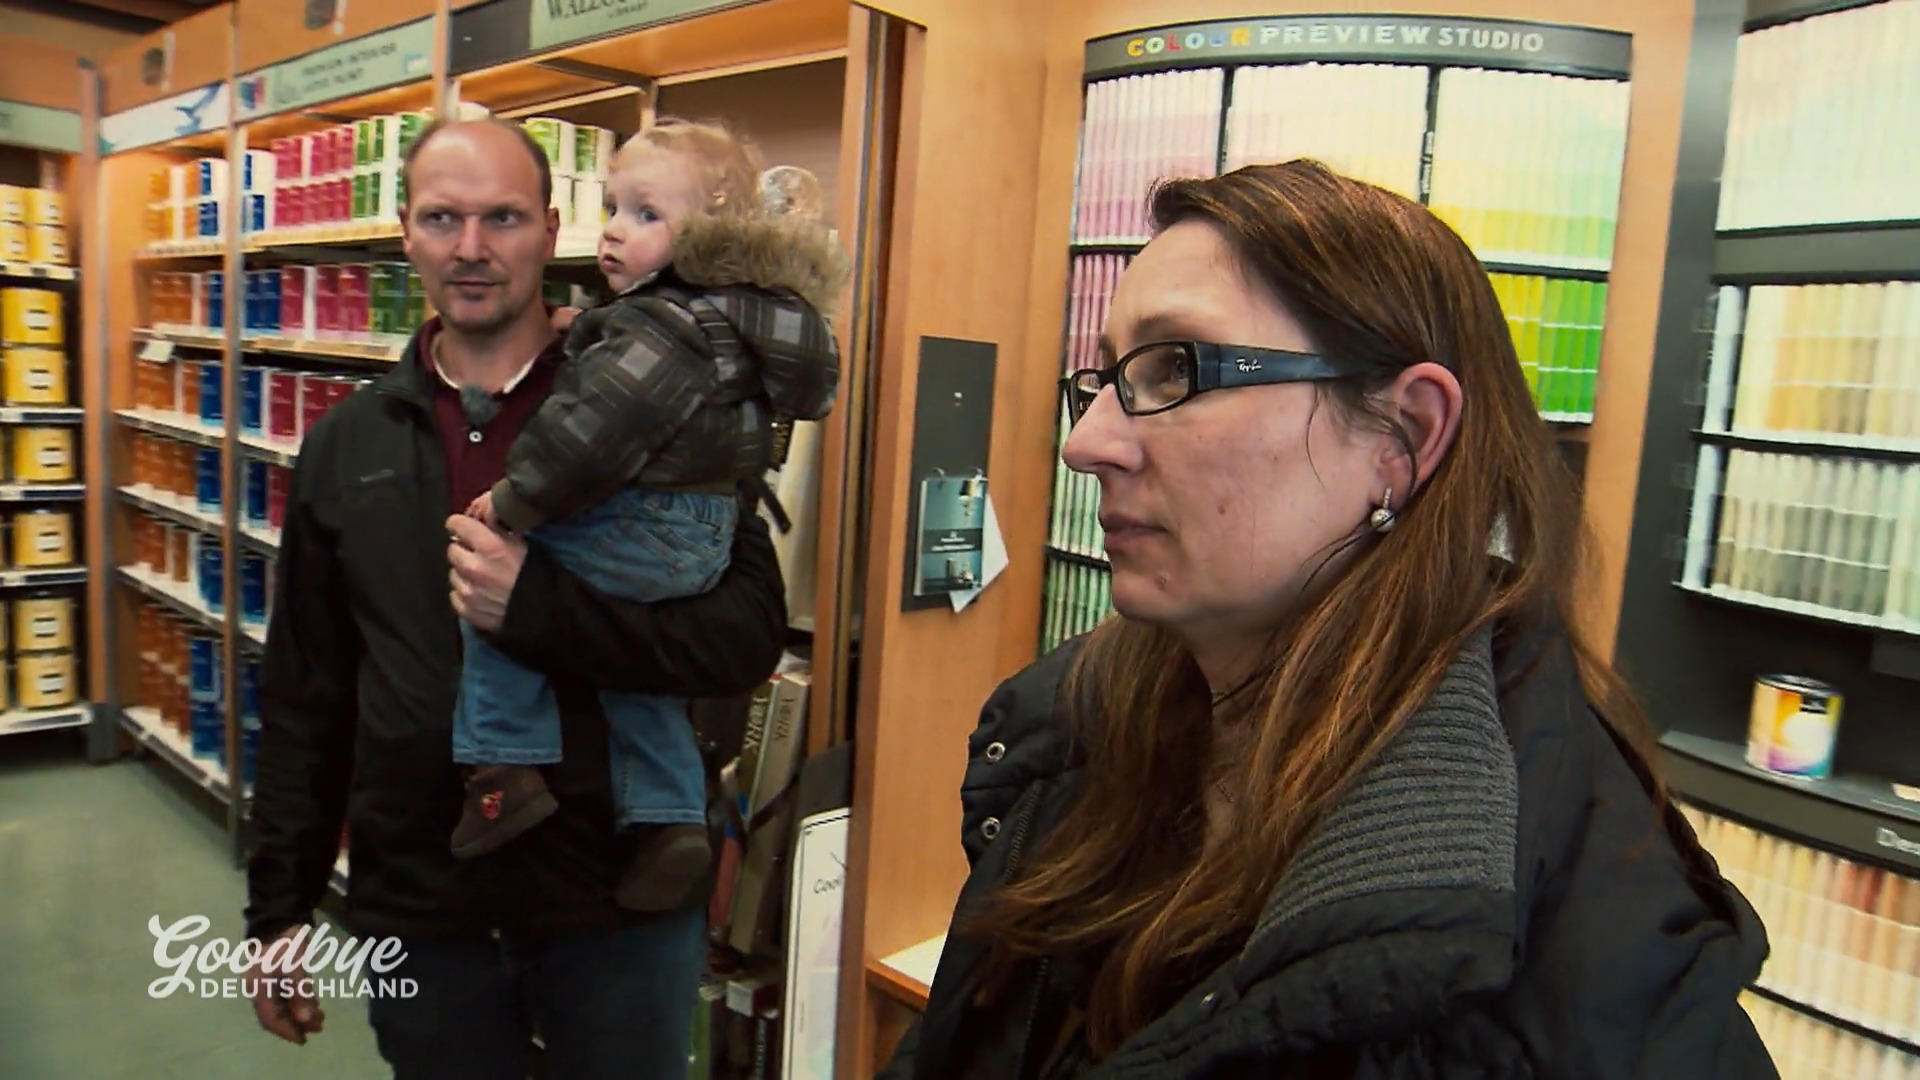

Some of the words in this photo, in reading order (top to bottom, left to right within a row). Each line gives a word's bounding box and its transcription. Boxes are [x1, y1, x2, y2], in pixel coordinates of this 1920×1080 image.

[1127, 27, 1250, 57] COLOUR
[1260, 23, 1431, 46] PREVIEW
[1438, 27, 1544, 52] STUDIO
